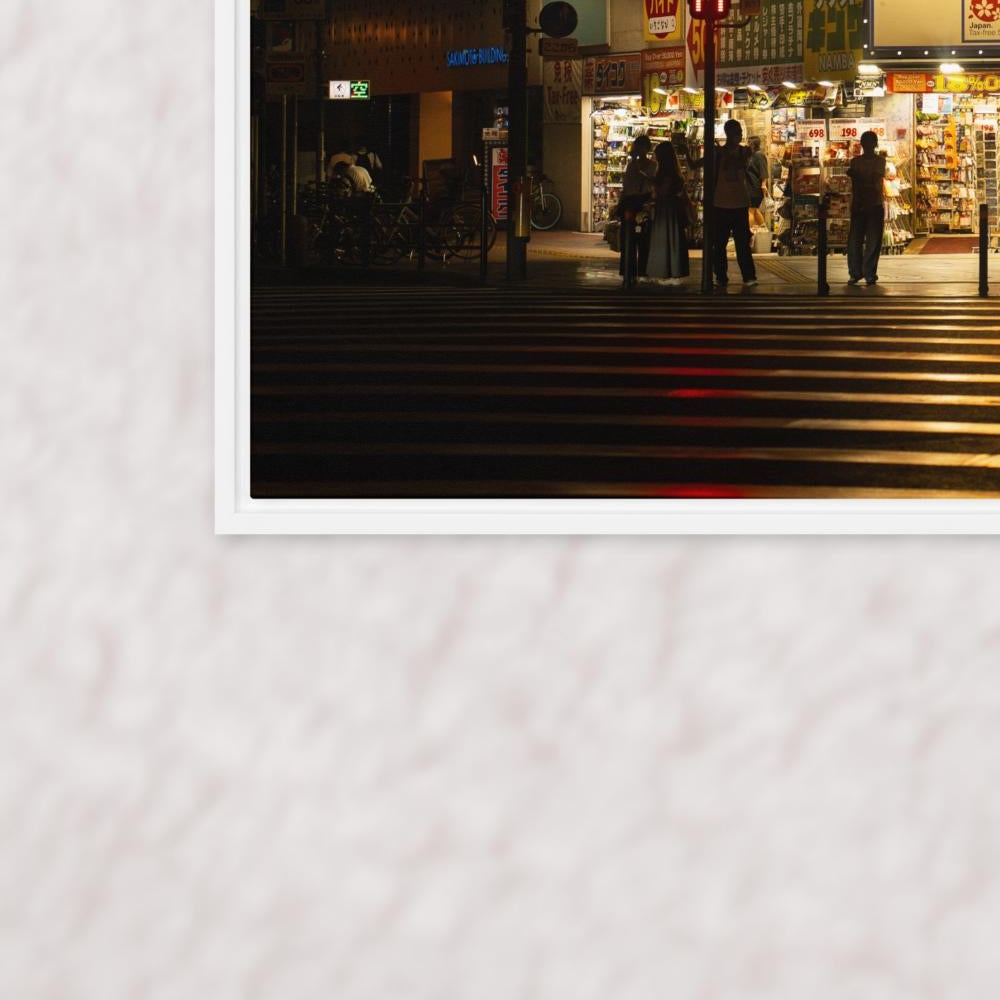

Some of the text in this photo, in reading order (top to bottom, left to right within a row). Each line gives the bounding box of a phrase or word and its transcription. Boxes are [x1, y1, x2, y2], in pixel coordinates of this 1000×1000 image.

[818, 54, 856, 73] NAMBA
[351, 81, 368, 98] 空
[808, 128, 824, 138] 698
[842, 127, 857, 138] 198
